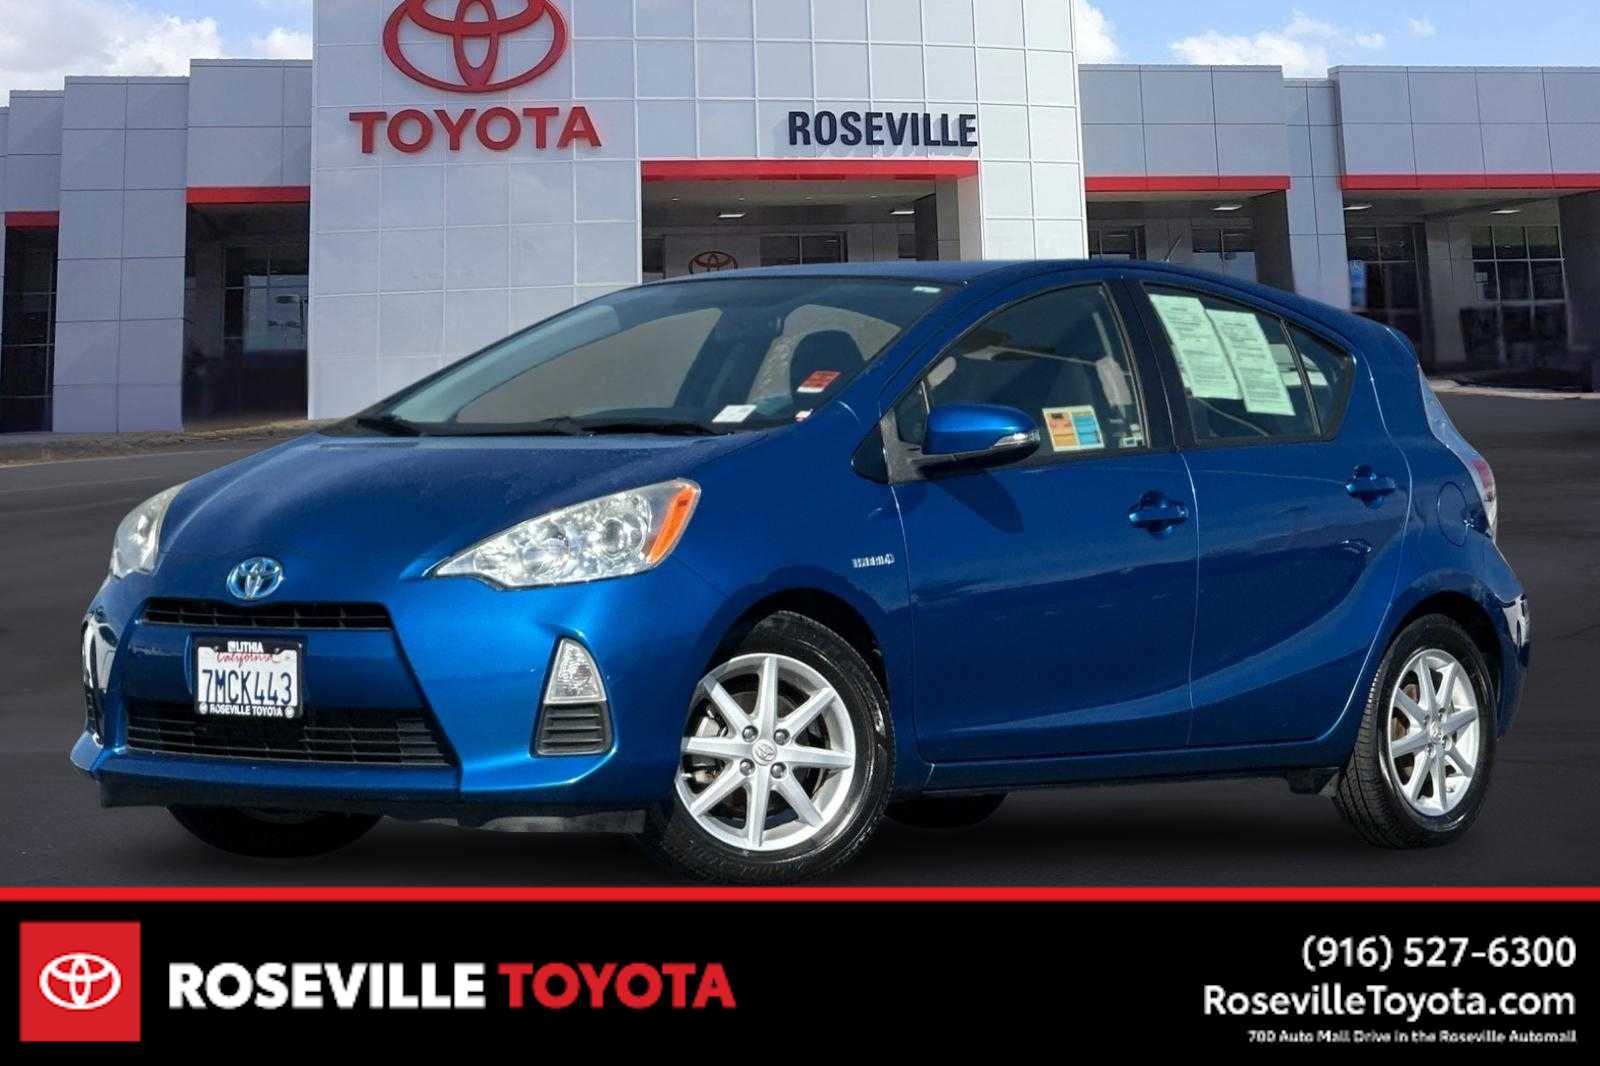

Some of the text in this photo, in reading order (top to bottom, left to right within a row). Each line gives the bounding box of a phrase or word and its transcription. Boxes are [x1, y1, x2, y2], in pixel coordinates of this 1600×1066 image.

[349, 106, 603, 154] TOYOTA
[788, 111, 978, 147] ROSEVILLE
[236, 641, 264, 653] LITHIA
[202, 669, 292, 705] 7MCK443
[210, 703, 283, 717] ROSEVILLE TOYOTA
